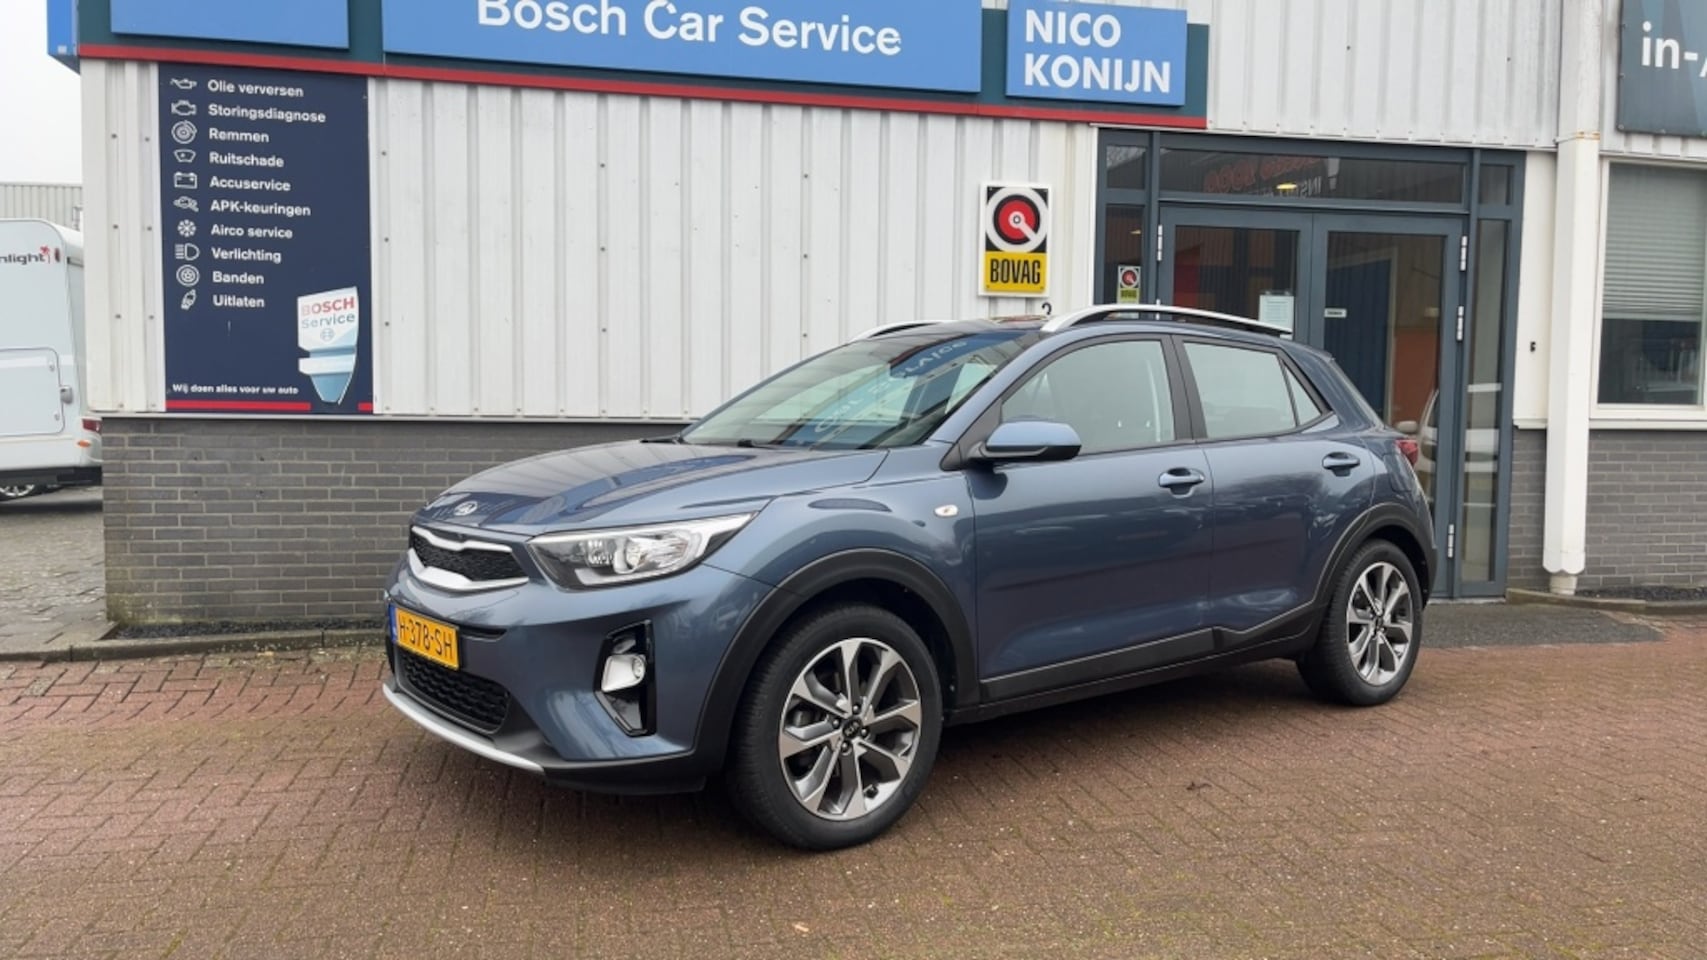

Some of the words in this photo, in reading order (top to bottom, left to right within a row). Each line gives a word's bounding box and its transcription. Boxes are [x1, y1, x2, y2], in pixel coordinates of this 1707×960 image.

[478, 0, 626, 35] Bosch
[644, 0, 723, 42] Car
[739, 7, 901, 55] Service
[1025, 9, 1121, 48] NICO
[1025, 53, 1170, 93] KONIJN
[207, 79, 236, 93] Olie
[237, 84, 304, 97] verversen
[207, 103, 327, 123] Storingsdiagnose
[208, 127, 270, 143] Remmen
[209, 151, 285, 168] Ruitschade
[209, 175, 291, 192] Accuservice
[210, 199, 312, 218] APK-keuringen
[210, 223, 245, 237] Airco
[247, 226, 293, 239] service
[210, 246, 282, 265] Verlichting
[212, 270, 265, 285] Banden
[989, 258, 1041, 285] BOVAG
[212, 294, 265, 308] Uitlaten
[301, 296, 355, 316] BOSCH
[301, 313, 355, 329] Service
[172, 383, 189, 394] Wij
[190, 383, 215, 393] doen
[215, 383, 238, 393] alles
[239, 385, 261, 394] voor
[262, 386, 277, 394] uw
[277, 386, 299, 395] auto
[399, 613, 453, 660] H-378-SH
